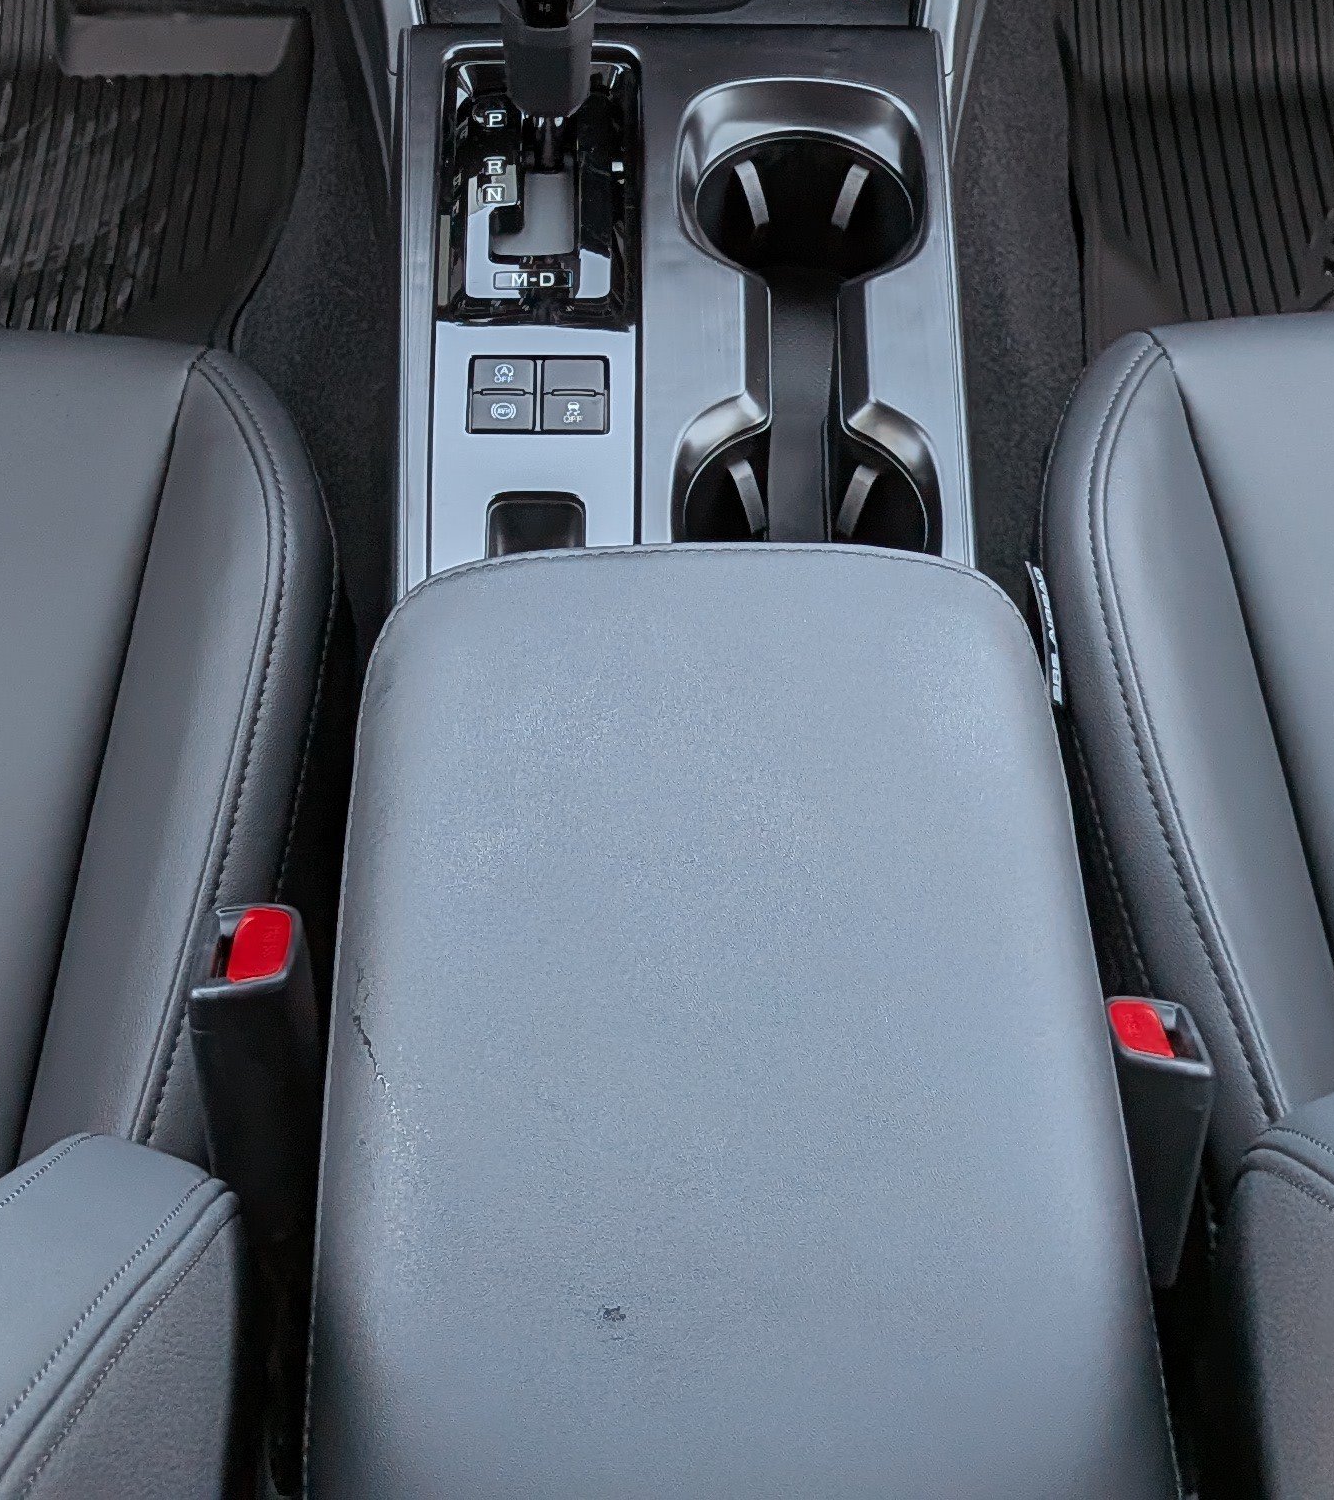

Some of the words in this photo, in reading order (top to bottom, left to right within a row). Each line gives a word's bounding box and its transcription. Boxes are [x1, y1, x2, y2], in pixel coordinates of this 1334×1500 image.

[488, 113, 504, 128] P
[487, 160, 504, 175] R
[486, 187, 503, 202] N
[510, 272, 556, 287] M-D
[494, 375, 515, 384] OFF
[563, 415, 584, 424] OFF
